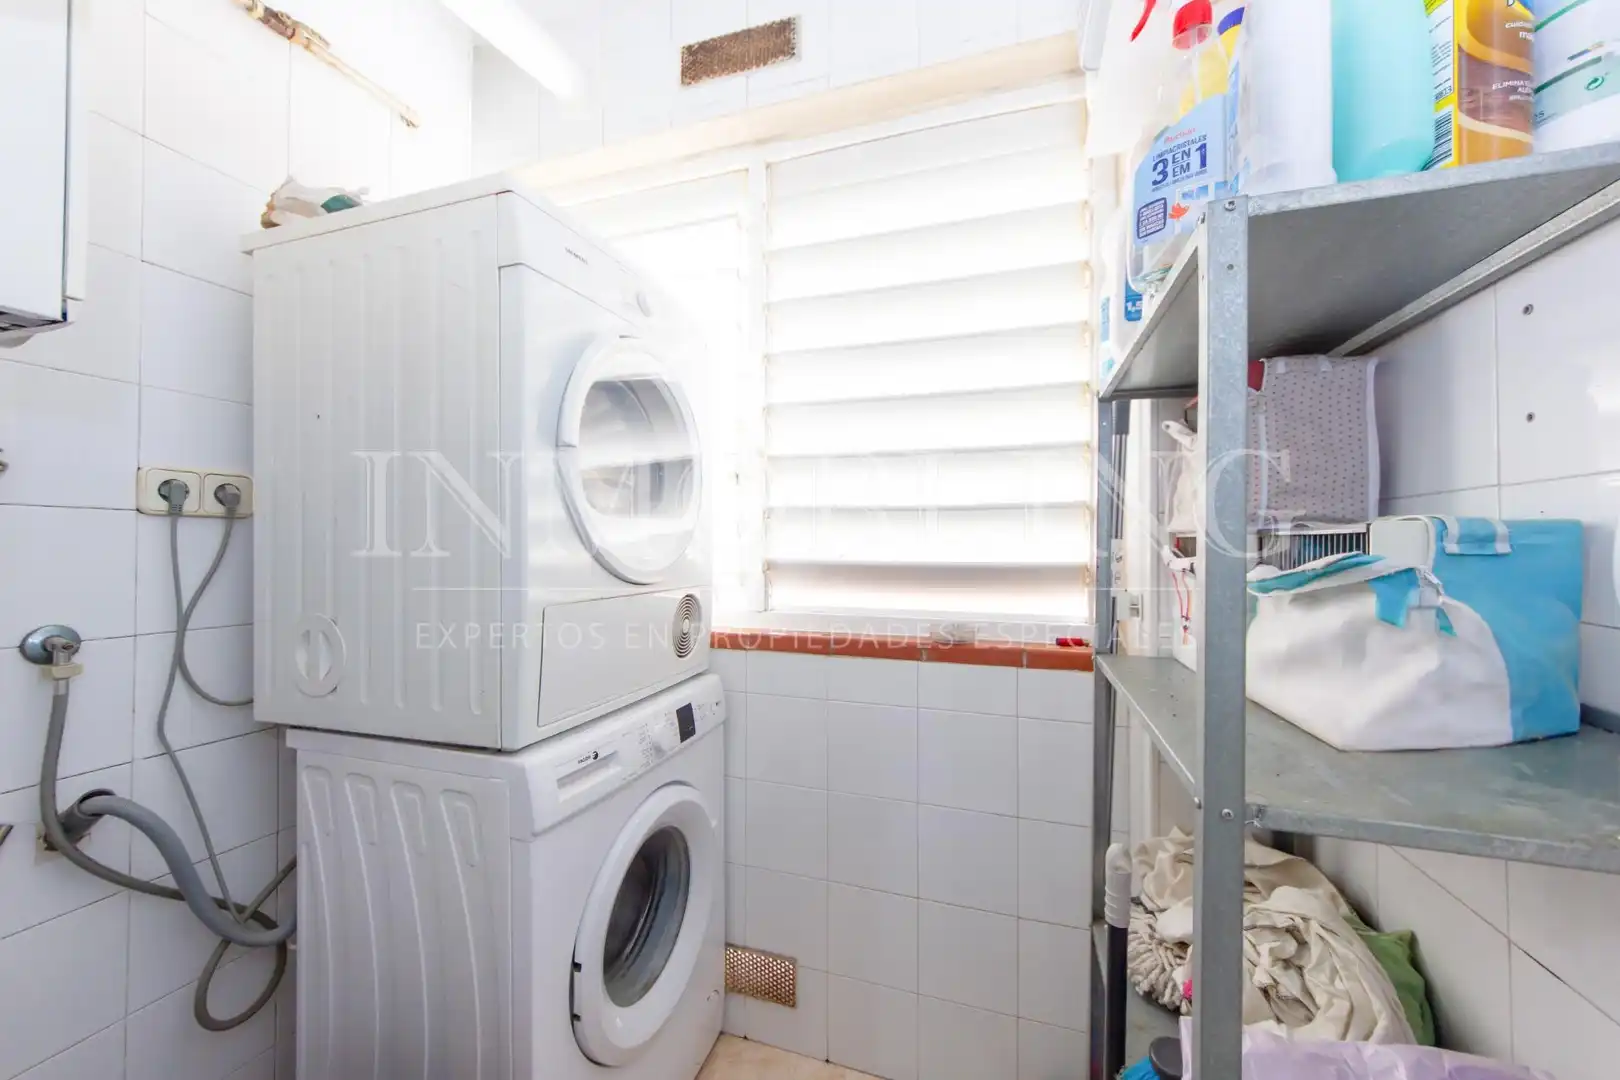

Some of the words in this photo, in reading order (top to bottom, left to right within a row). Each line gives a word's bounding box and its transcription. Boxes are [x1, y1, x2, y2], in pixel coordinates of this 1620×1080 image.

[1152, 134, 1207, 162] LIMPIACRISTALES
[1151, 158, 1169, 186] 3
[1171, 147, 1191, 164] EN
[1194, 142, 1207, 170] 1
[1172, 162, 1190, 178] EM
